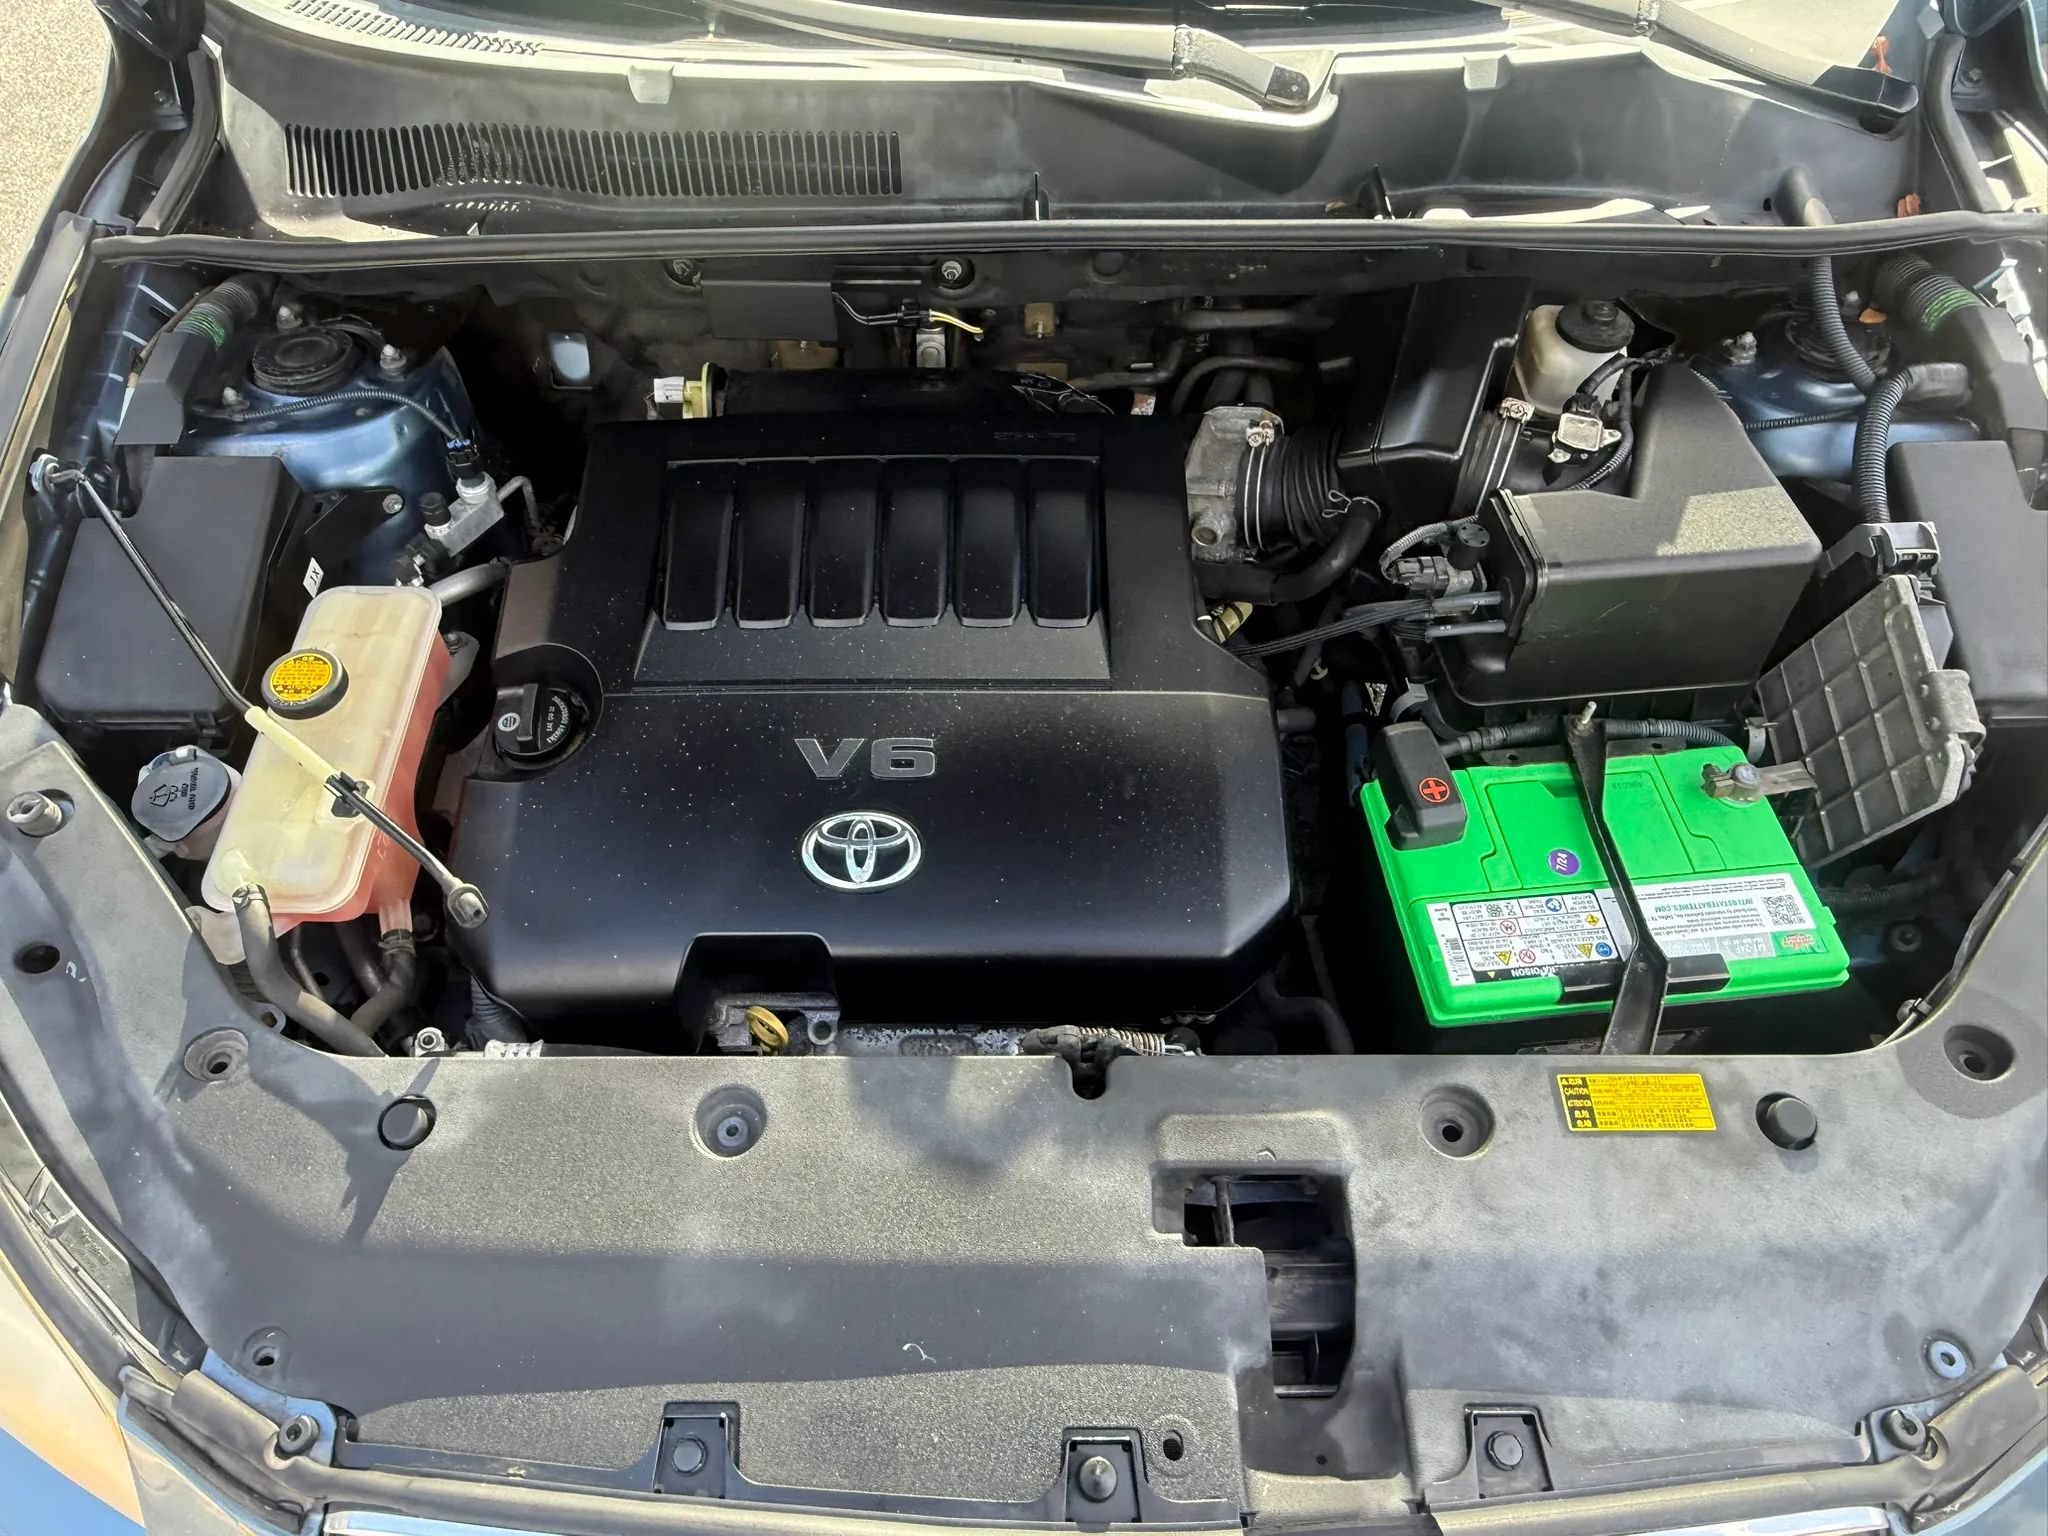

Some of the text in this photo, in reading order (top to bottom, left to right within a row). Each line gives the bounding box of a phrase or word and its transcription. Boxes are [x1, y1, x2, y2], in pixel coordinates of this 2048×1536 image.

[794, 737, 935, 779] V6
[1555, 852, 1569, 871] 7/24
[1654, 898, 1754, 914] INTERSTATEBATTERIES.COM
